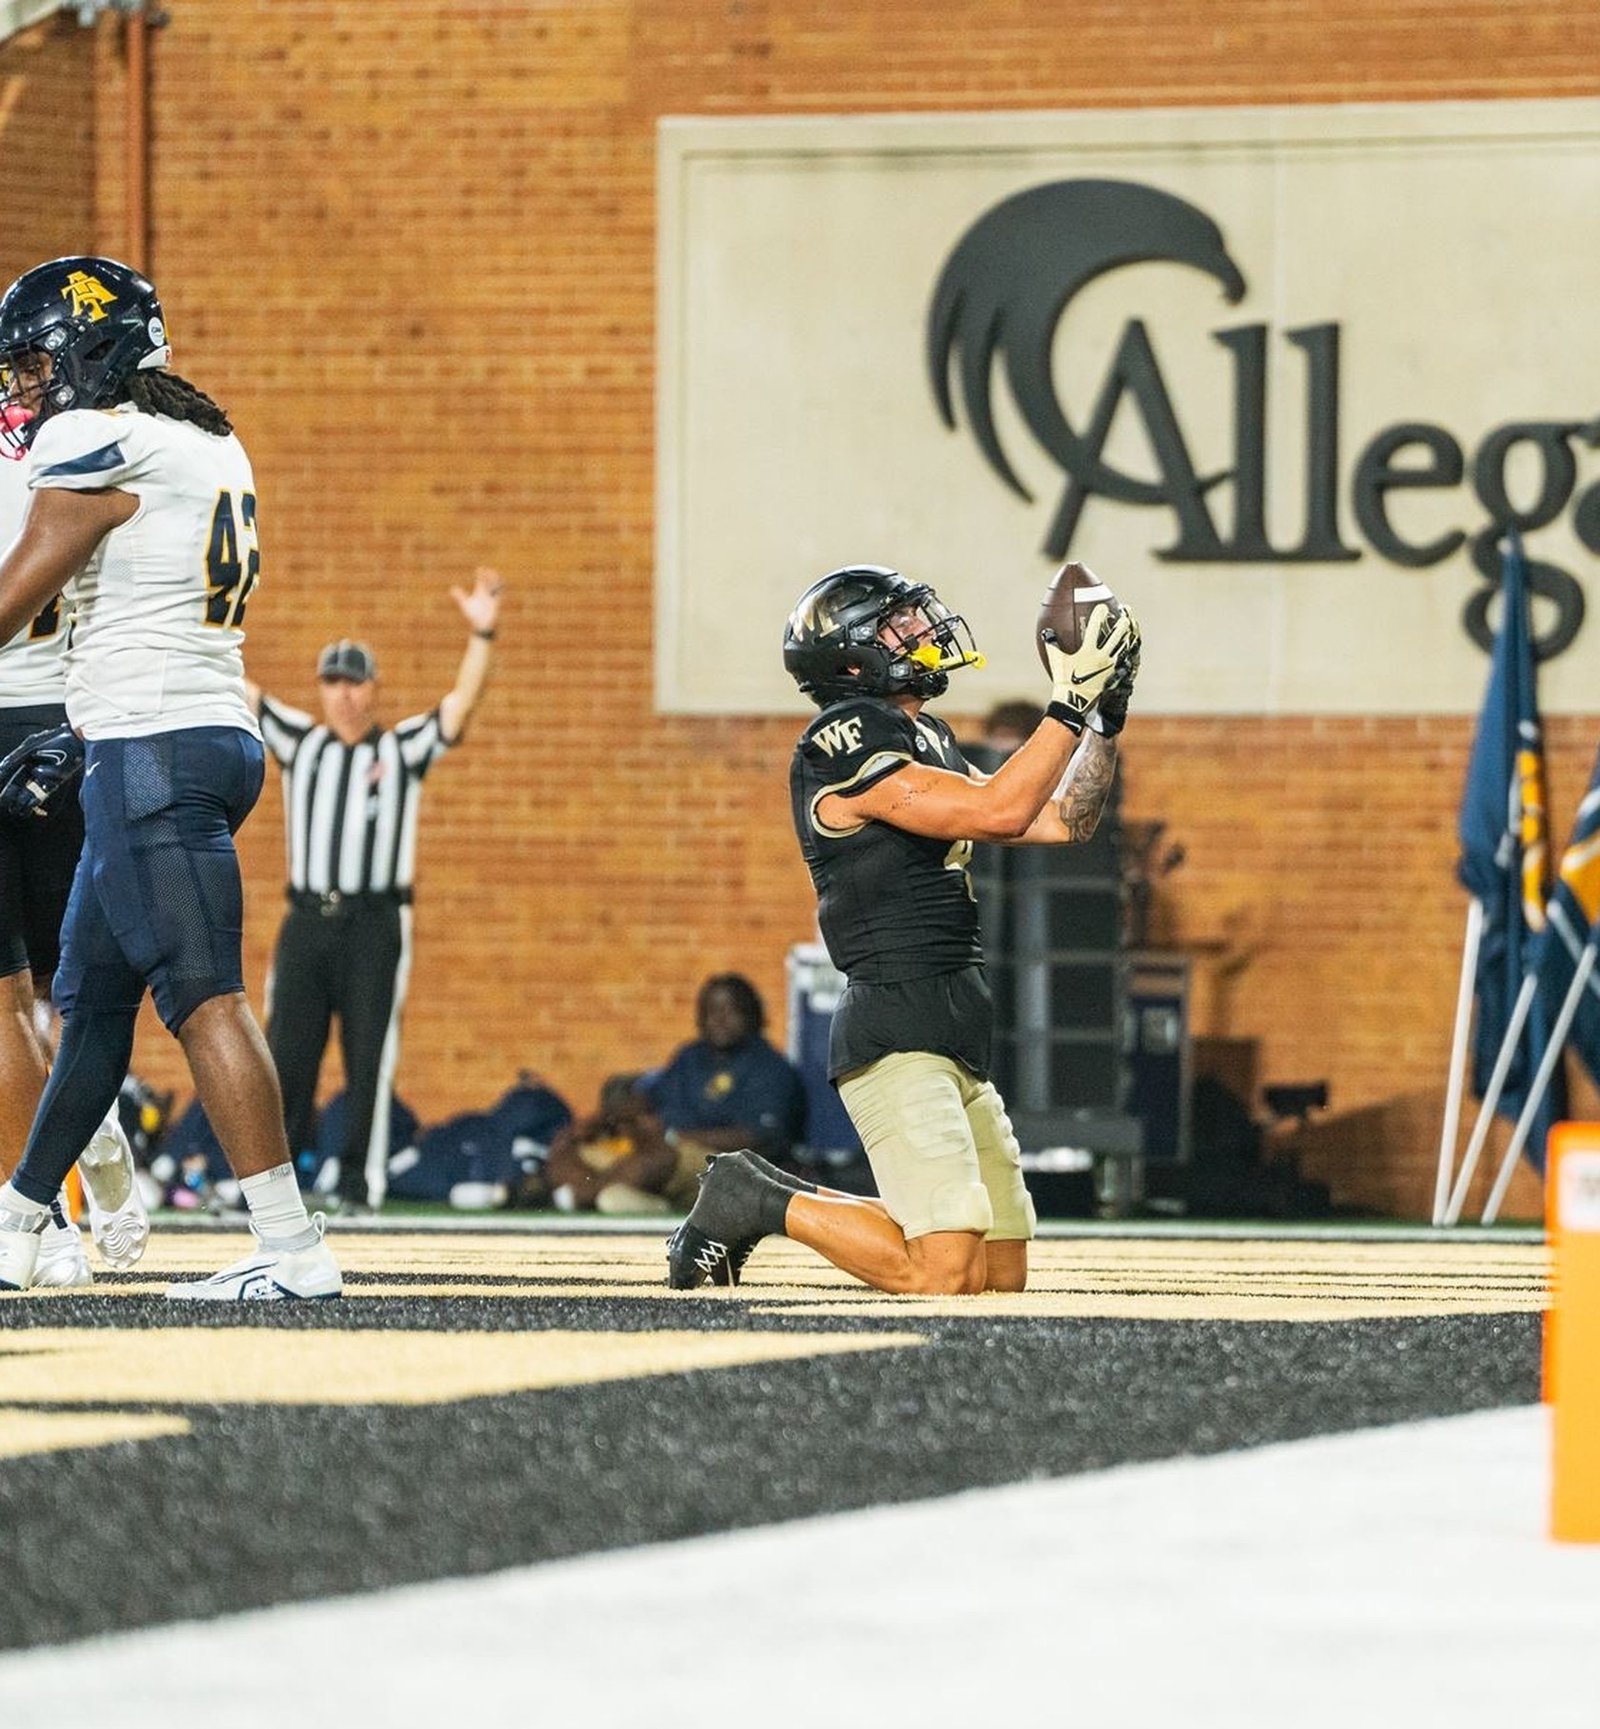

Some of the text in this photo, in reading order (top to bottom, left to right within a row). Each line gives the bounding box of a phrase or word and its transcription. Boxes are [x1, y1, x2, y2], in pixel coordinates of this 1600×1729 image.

[203, 488, 260, 628] 42
[1042, 317, 1600, 662] Alleg
[812, 716, 863, 758] WF
